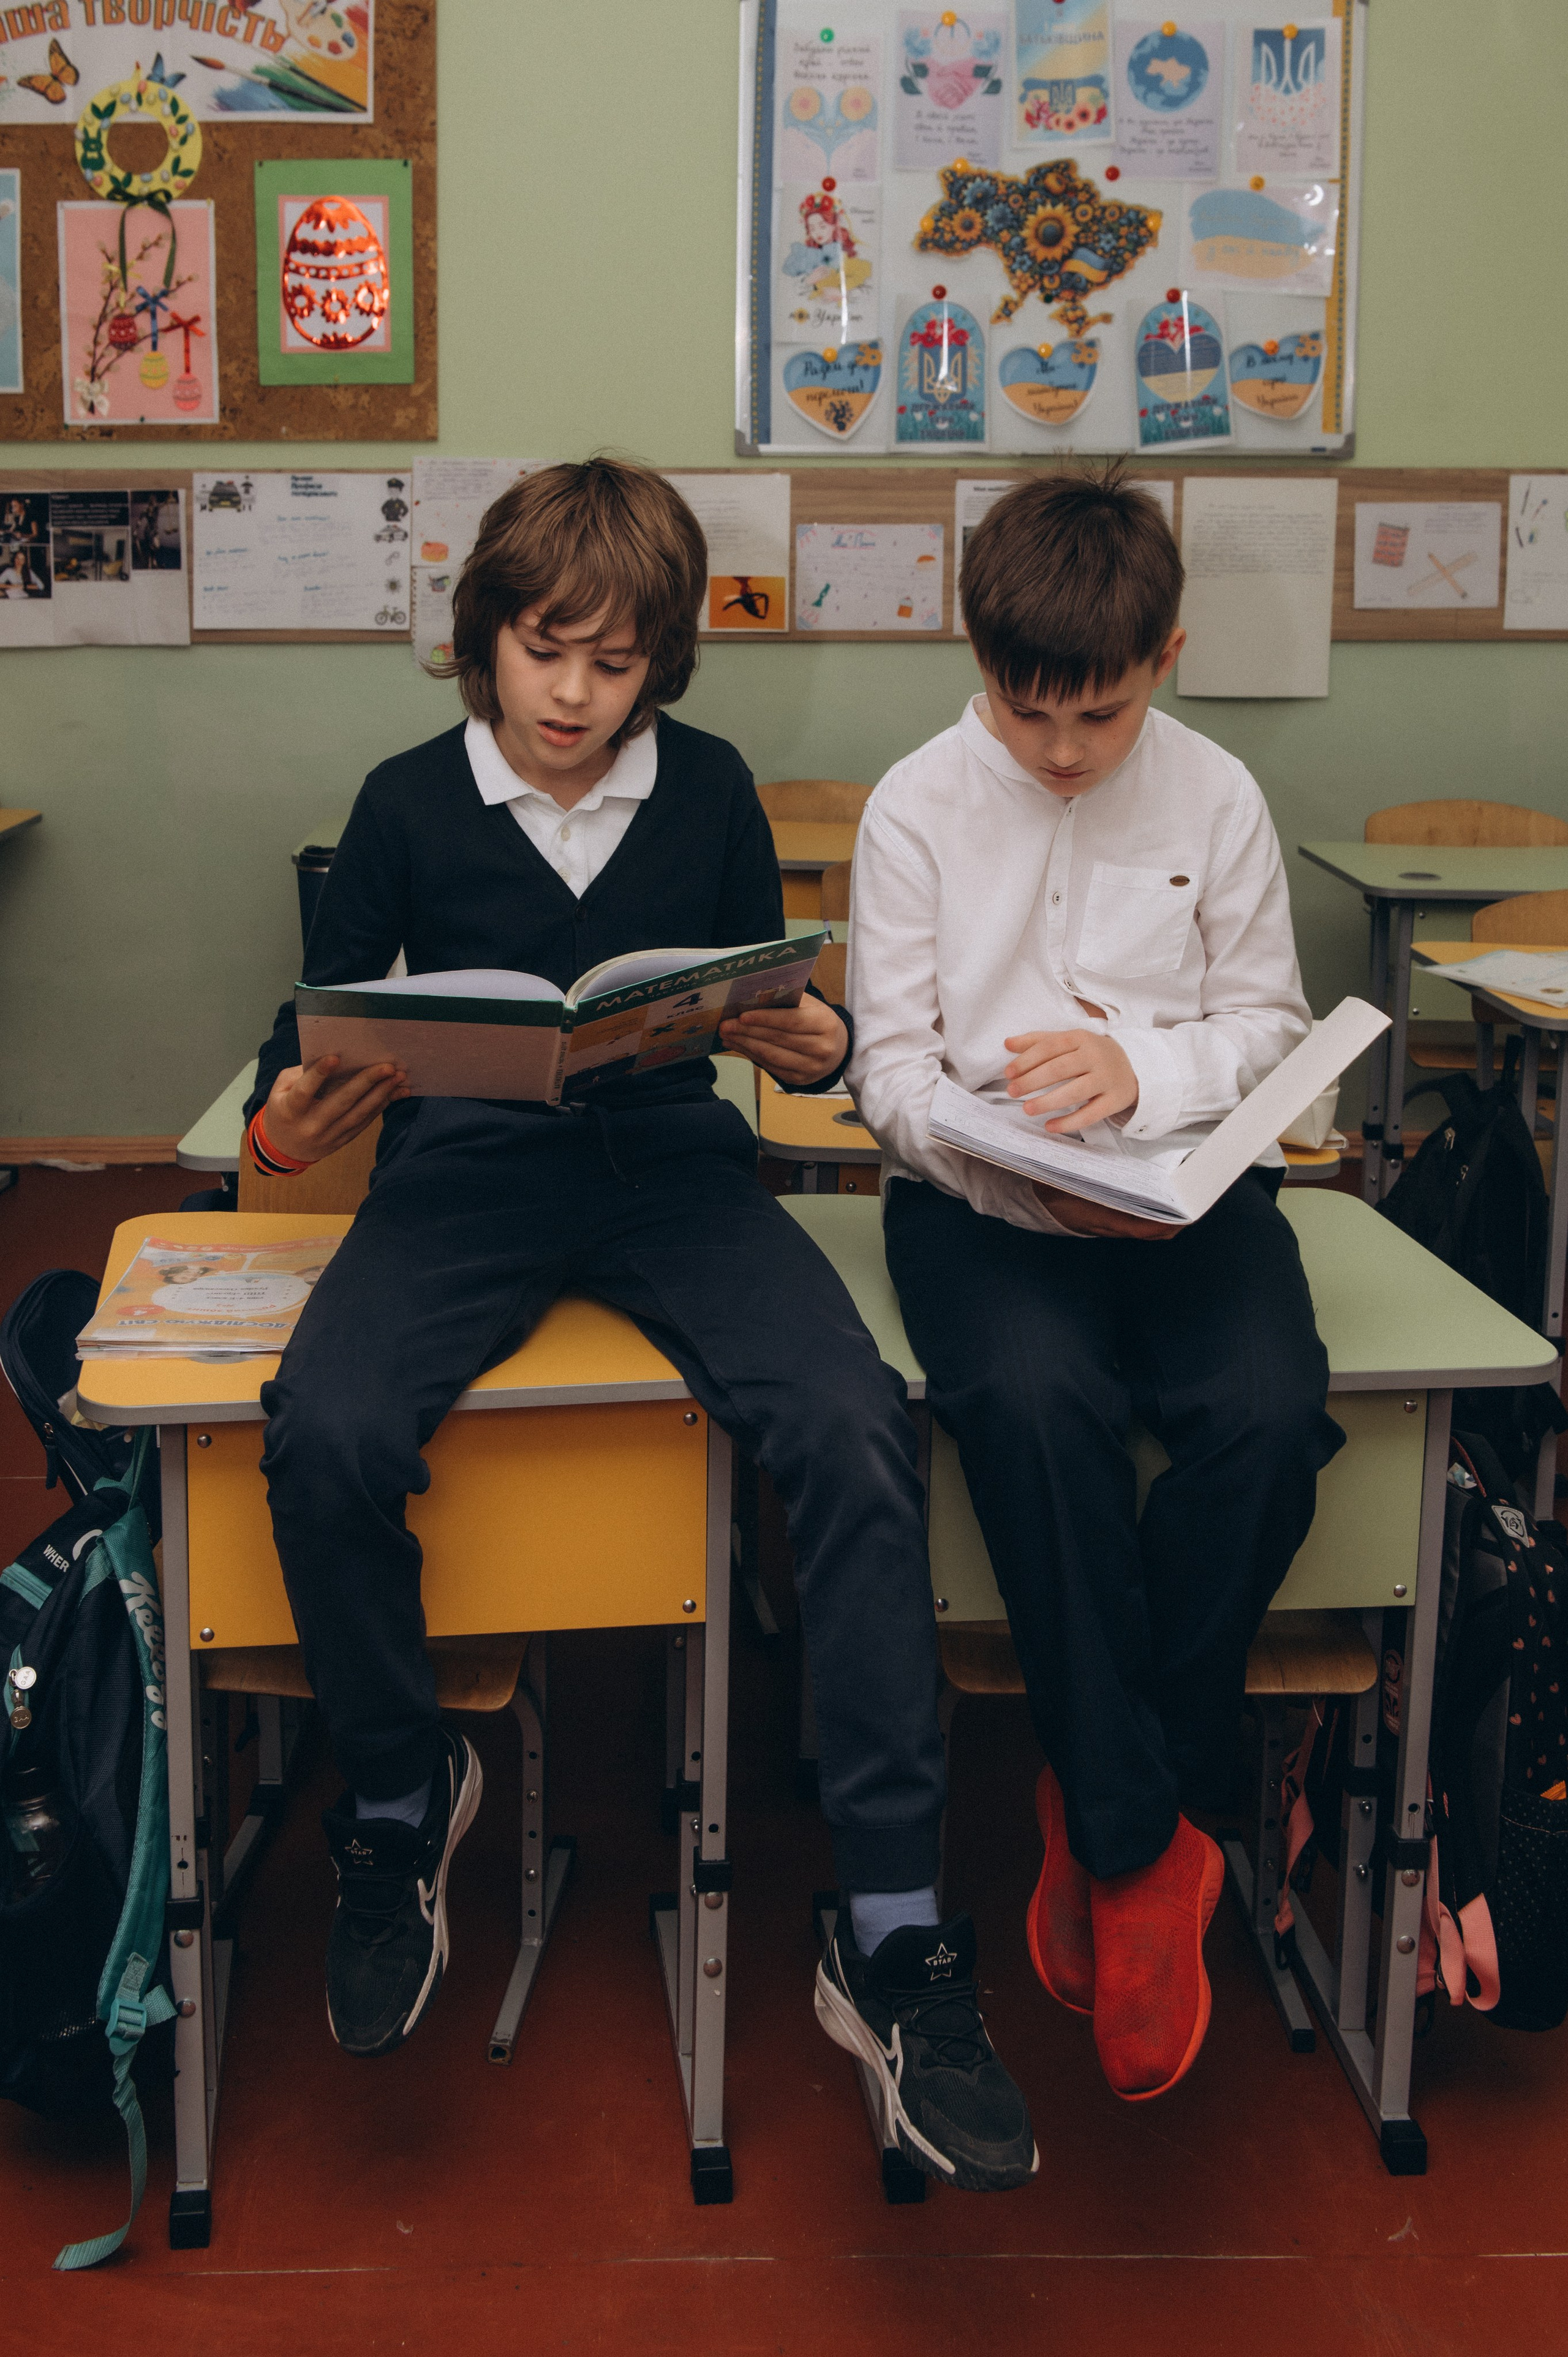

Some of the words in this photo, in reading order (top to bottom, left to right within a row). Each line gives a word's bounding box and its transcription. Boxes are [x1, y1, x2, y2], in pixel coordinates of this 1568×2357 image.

[78, 0, 290, 54] творчість
[596, 946, 797, 1011] МАТЕМАТИКА
[672, 992, 703, 1009] 4
[666, 1005, 704, 1019] клас
[165, 1319, 288, 1329] ДОСЛІДЖУЮ
[43, 1544, 70, 1573] WHER
[933, 1957, 951, 1966] STAR
